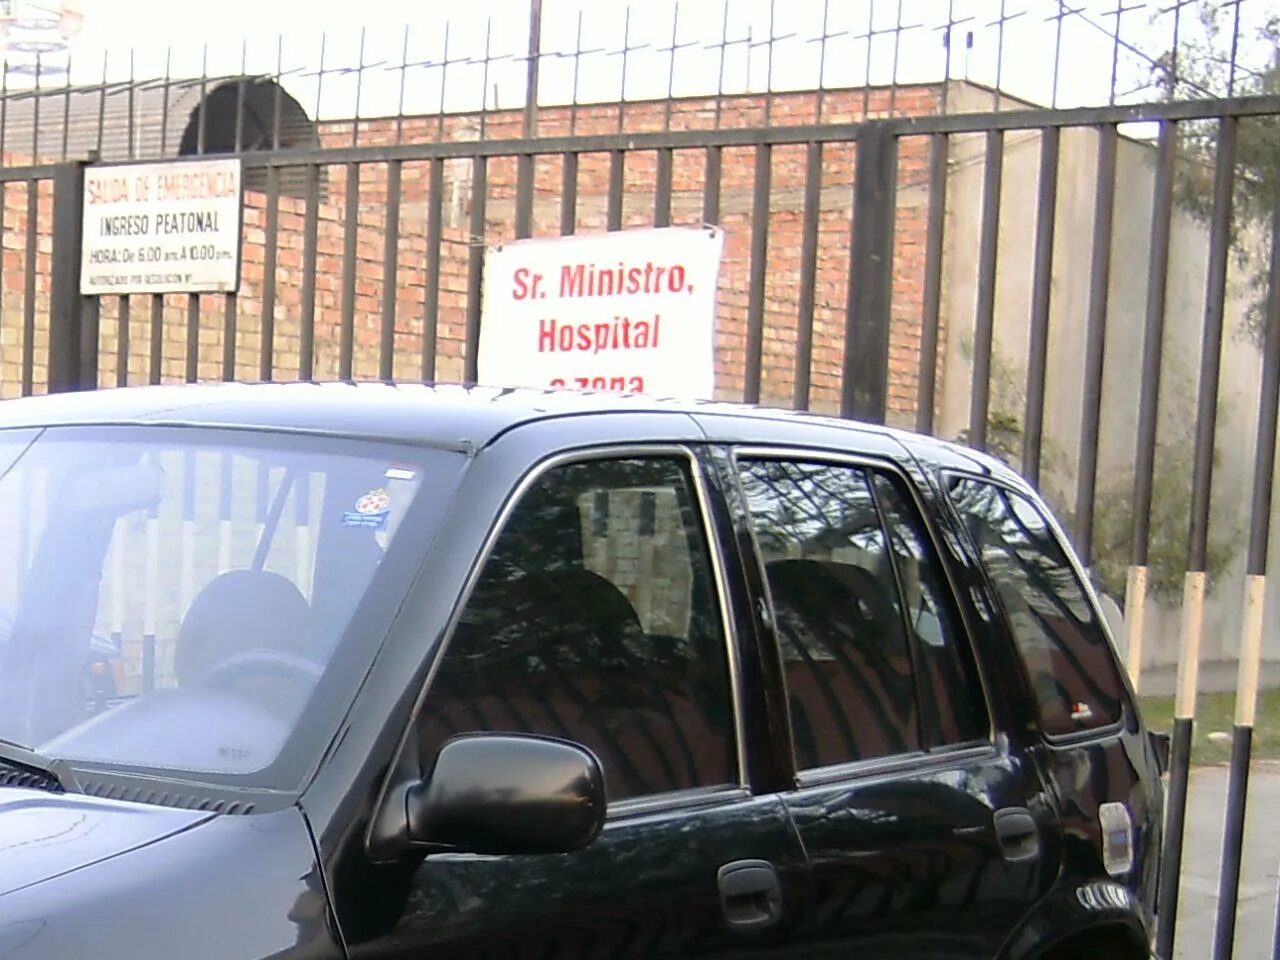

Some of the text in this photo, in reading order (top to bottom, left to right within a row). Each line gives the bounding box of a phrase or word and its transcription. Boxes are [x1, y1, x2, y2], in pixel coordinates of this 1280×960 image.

[135, 176, 150, 202] DE
[99, 210, 220, 237] INGRESO PEATONAL
[512, 261, 695, 301] Sr. Ministro,
[538, 313, 661, 356] Hospital
